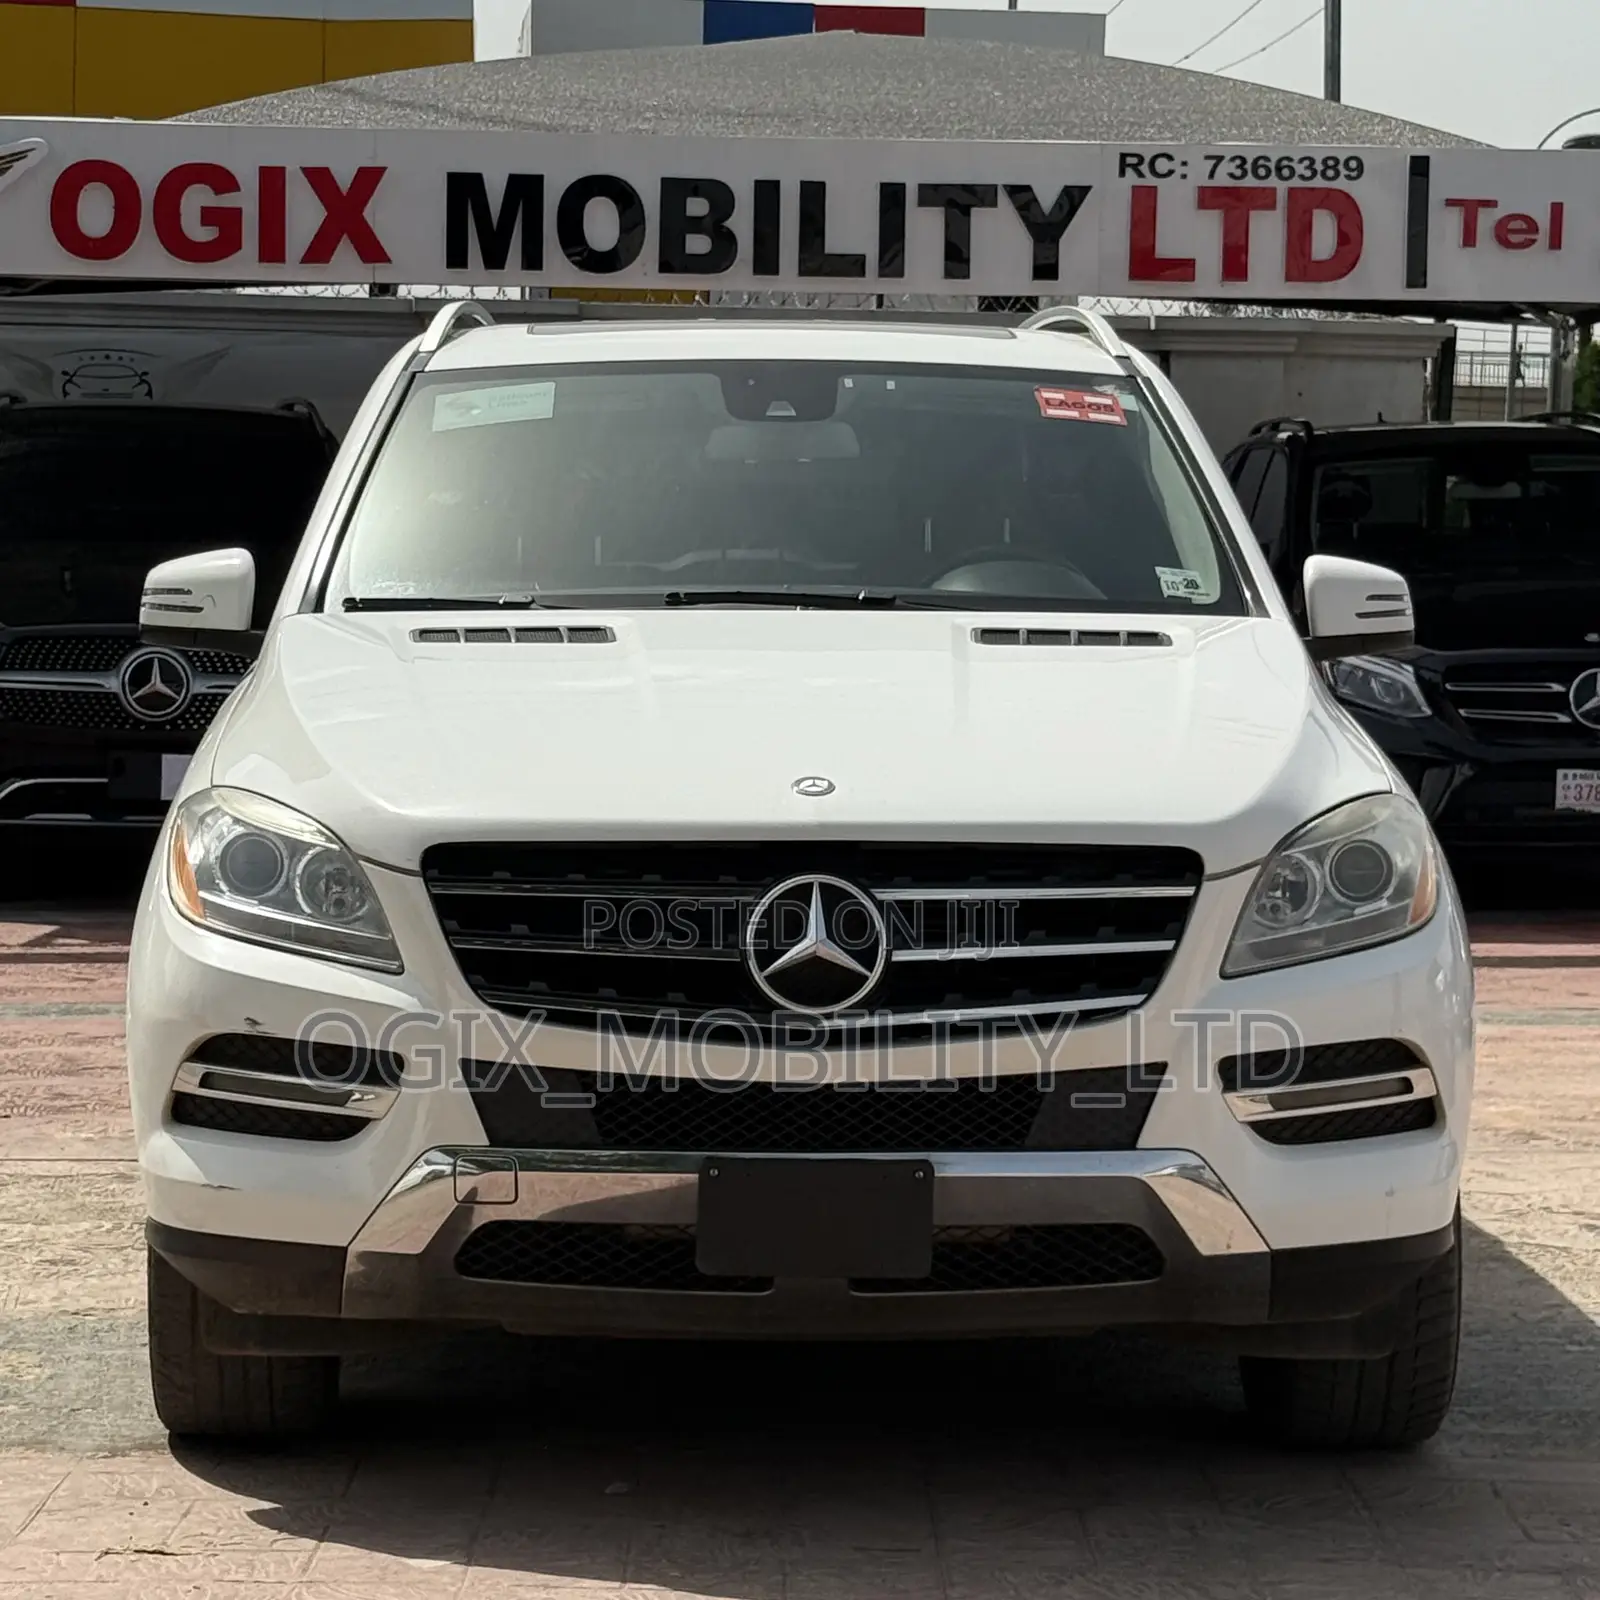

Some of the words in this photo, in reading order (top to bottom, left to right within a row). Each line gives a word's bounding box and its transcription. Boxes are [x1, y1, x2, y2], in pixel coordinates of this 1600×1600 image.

[1118, 152, 1189, 180] RC:
[1203, 154, 1365, 182] 7366389
[49, 158, 393, 265] OGIX
[445, 171, 1093, 282] MOBILITY
[1128, 184, 1365, 283] LTD
[1444, 197, 1565, 251] Tel
